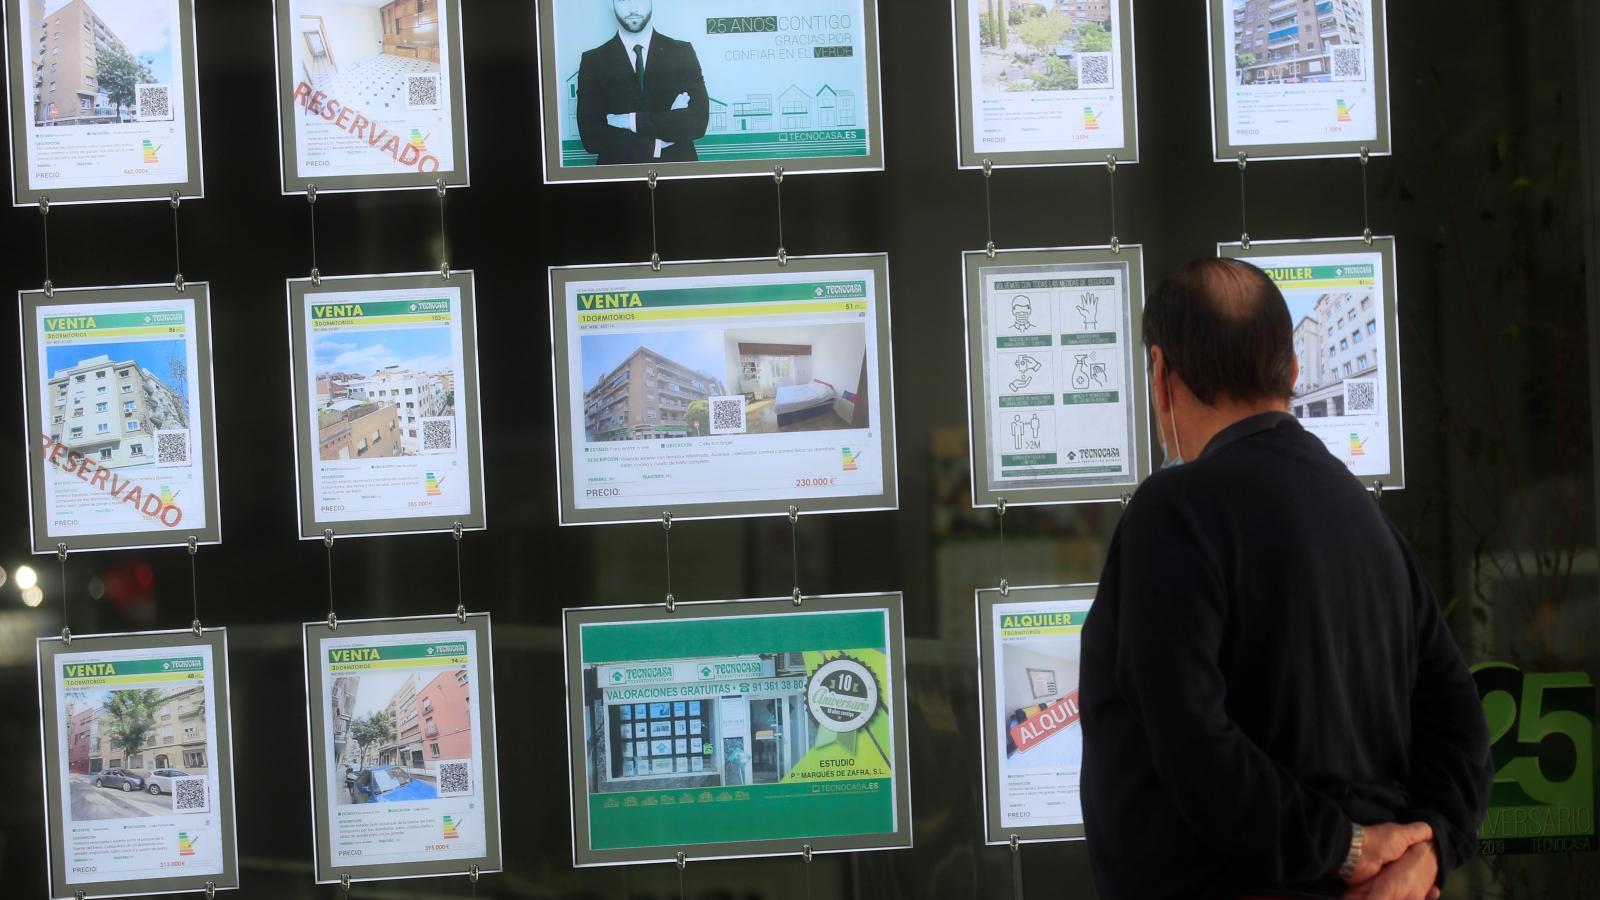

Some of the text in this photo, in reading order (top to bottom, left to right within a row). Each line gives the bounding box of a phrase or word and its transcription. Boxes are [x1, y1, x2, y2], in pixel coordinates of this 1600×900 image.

[708, 18, 727, 34] 25
[778, 14, 851, 31] CONTIGO
[775, 33, 851, 47] GRACIAS POR
[724, 45, 853, 62] CONFIAR EN EL VERDE
[294, 81, 440, 176] RESERVADO
[788, 131, 857, 142] TECNOCASA.ES
[580, 292, 643, 310] VENTA
[314, 304, 364, 318] VENTA
[46, 316, 97, 331] VENTA
[1078, 447, 1120, 459] TECNOCASA
[41, 434, 183, 528] RESERVADO
[795, 477, 828, 487] 230.000
[1003, 613, 1072, 628] ALQUILER
[331, 648, 380, 663] VENTA
[66, 663, 116, 677] VENTA
[625, 666, 673, 680] TECNOCASA
[714, 662, 761, 675] TECNOCASA
[838, 673, 853, 692] 10
[606, 679, 804, 701] VALORACIONES GRATUITAS 91 361 38 80
[1020, 698, 1080, 746] ALQUIL
[819, 758, 855, 768] ESTUDIO
[836, 769, 846, 777] DE
[821, 782, 879, 792] TECNOCASA.ES
